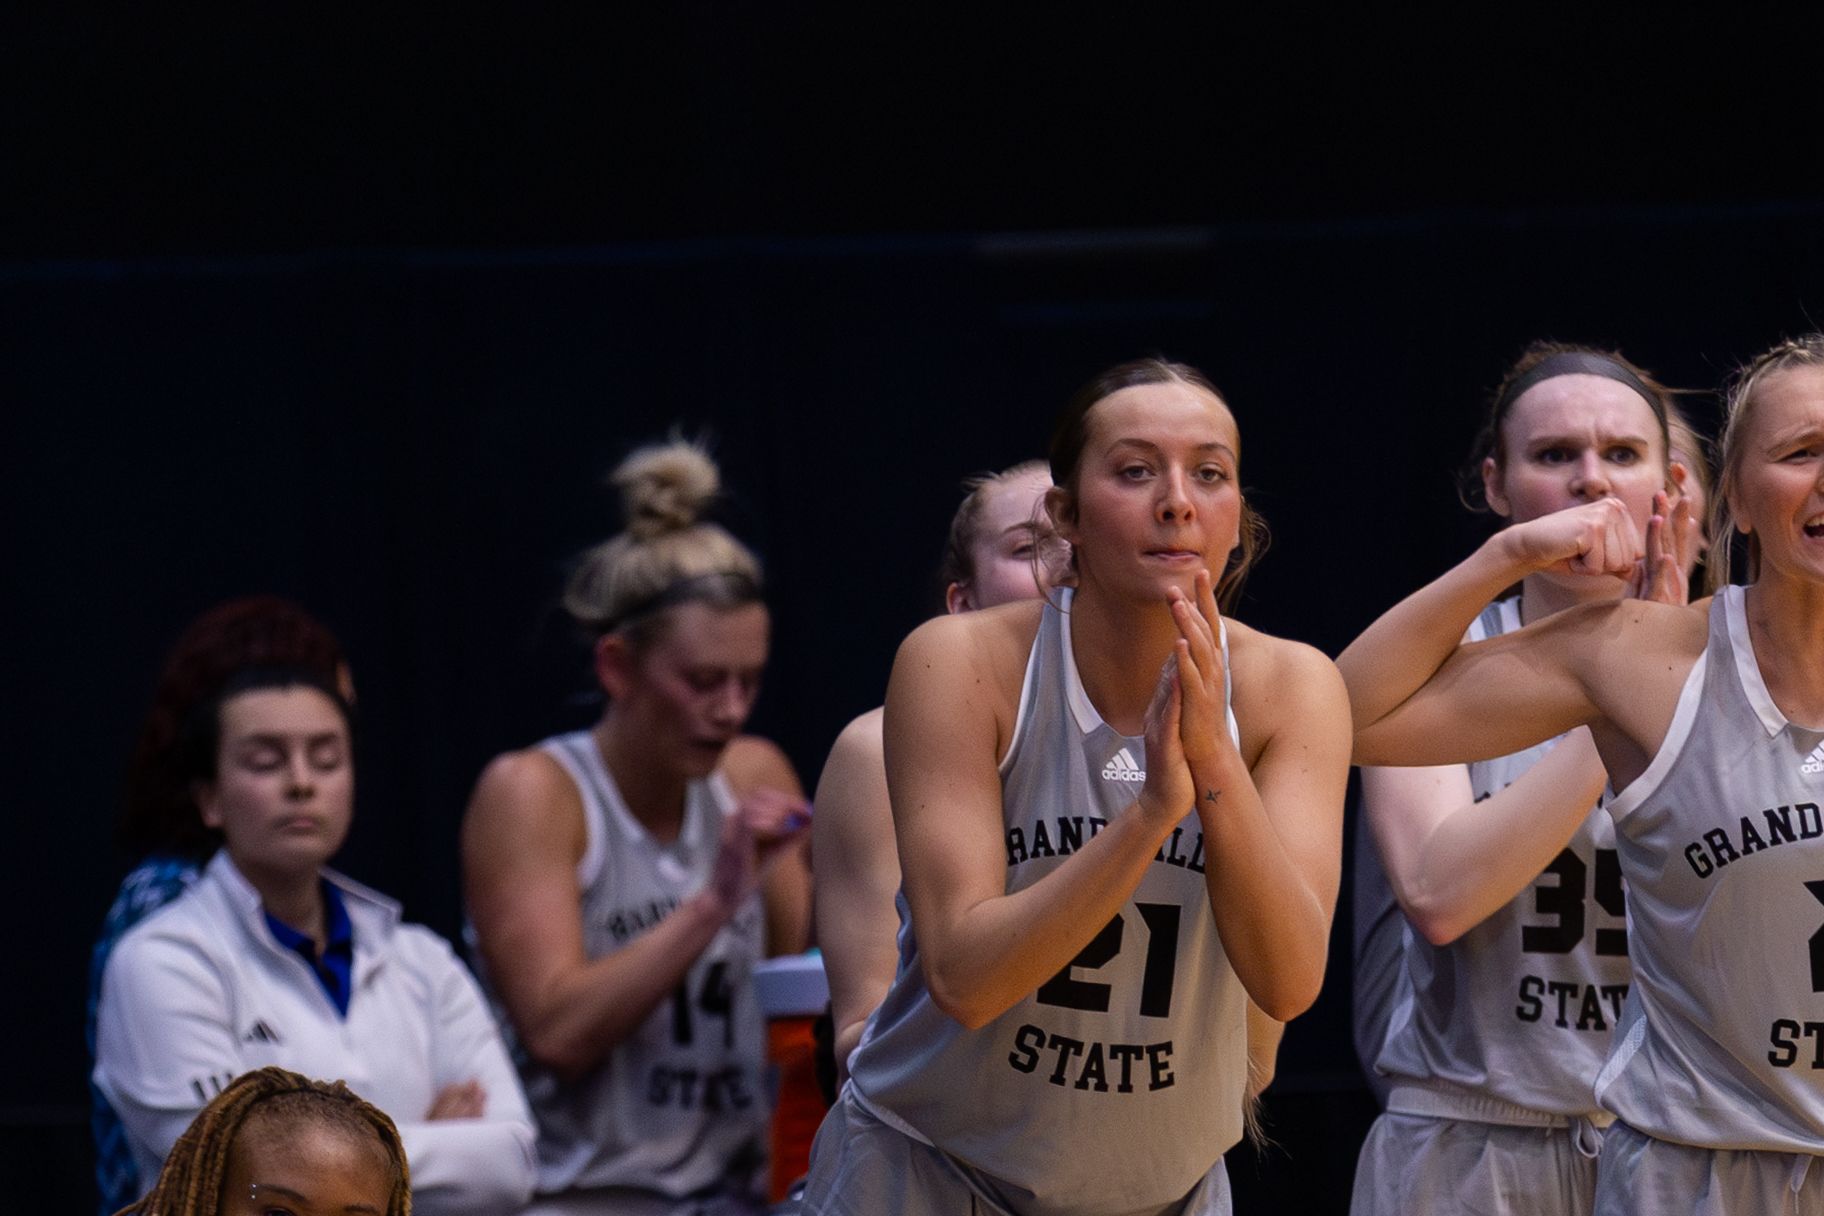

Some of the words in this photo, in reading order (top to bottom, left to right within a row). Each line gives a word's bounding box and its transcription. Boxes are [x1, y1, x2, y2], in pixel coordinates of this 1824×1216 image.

[1102, 769, 1146, 782] adidas
[1684, 802, 1824, 879] GRAND
[1036, 902, 1182, 1019] 21
[1516, 974, 1630, 1031] STAT
[1008, 1024, 1175, 1093] STATE
